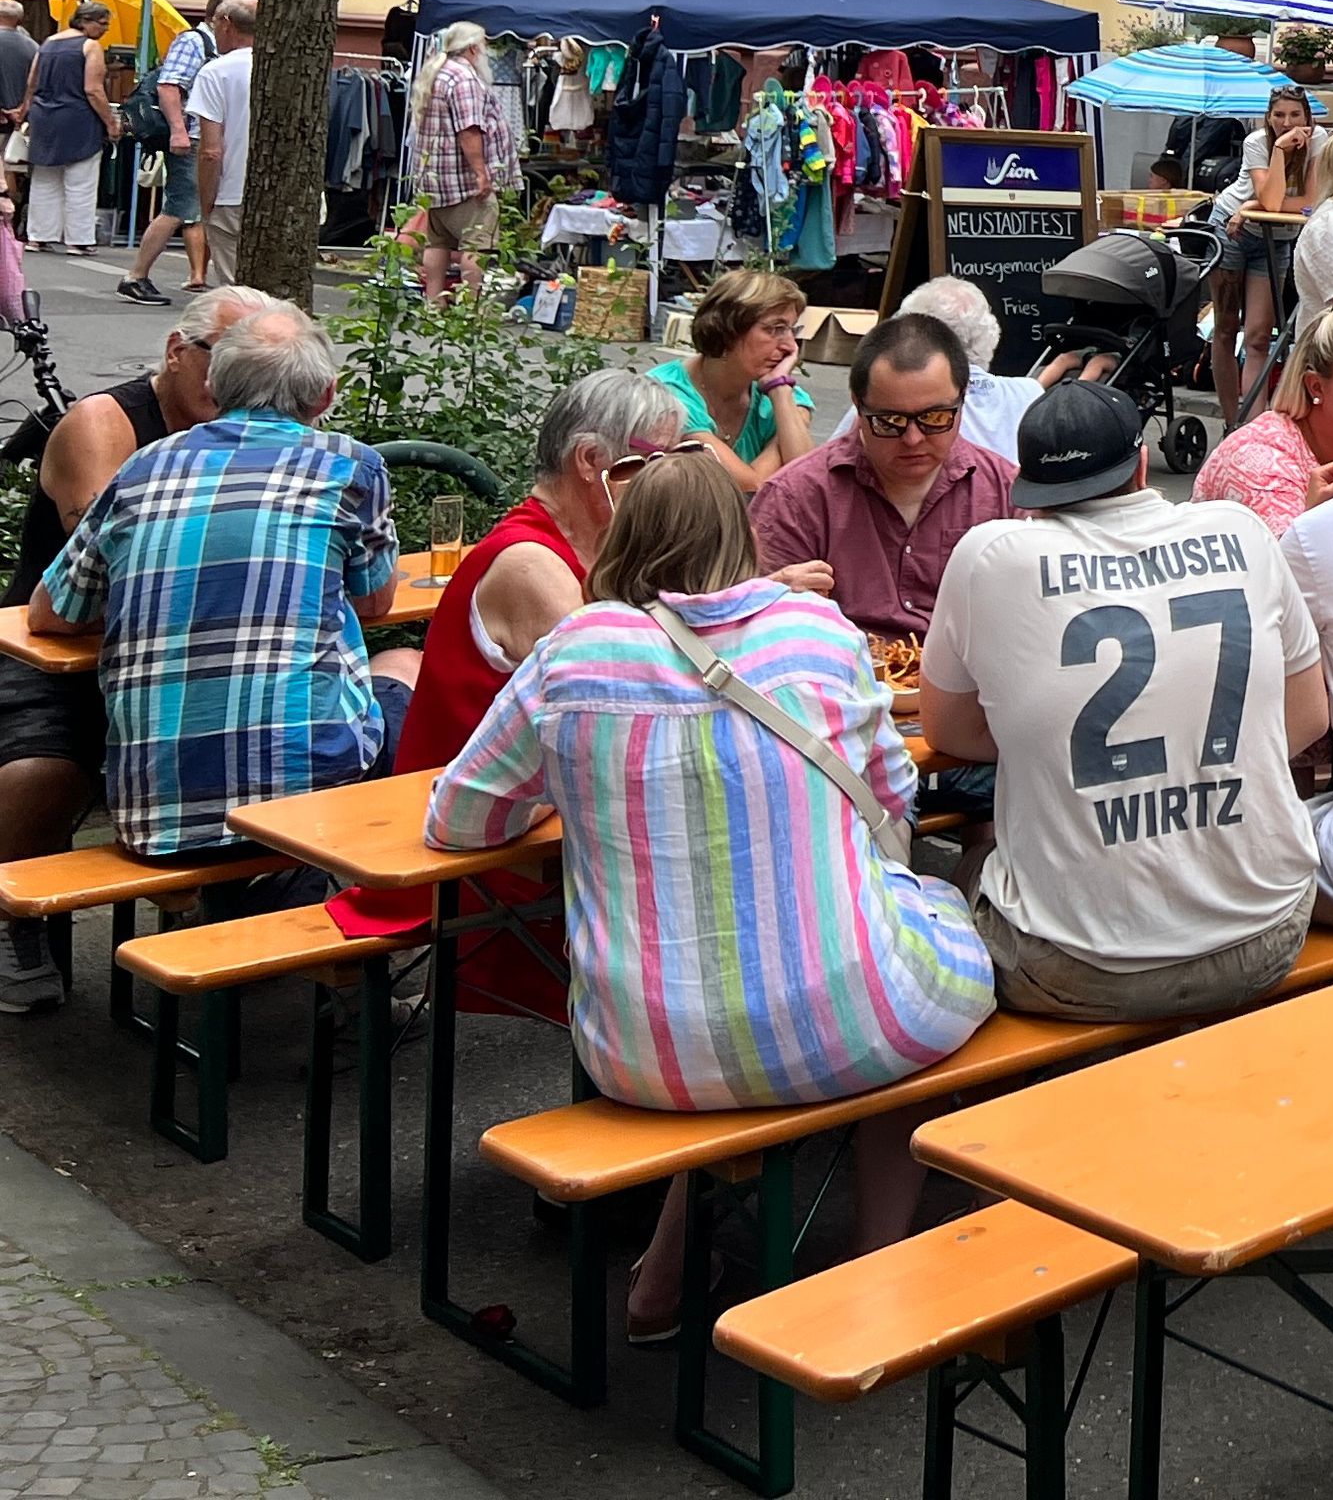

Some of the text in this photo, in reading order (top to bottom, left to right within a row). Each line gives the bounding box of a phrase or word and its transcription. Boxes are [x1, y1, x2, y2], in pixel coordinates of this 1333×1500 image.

[984, 153, 1040, 186] Sion
[947, 210, 1077, 236] NEUSTADTFEST
[1001, 297, 1040, 317] Fries
[1039, 533, 1248, 598] LEVERKUSEN
[1060, 588, 1252, 790] 27
[1094, 777, 1243, 847] WIRTZ
